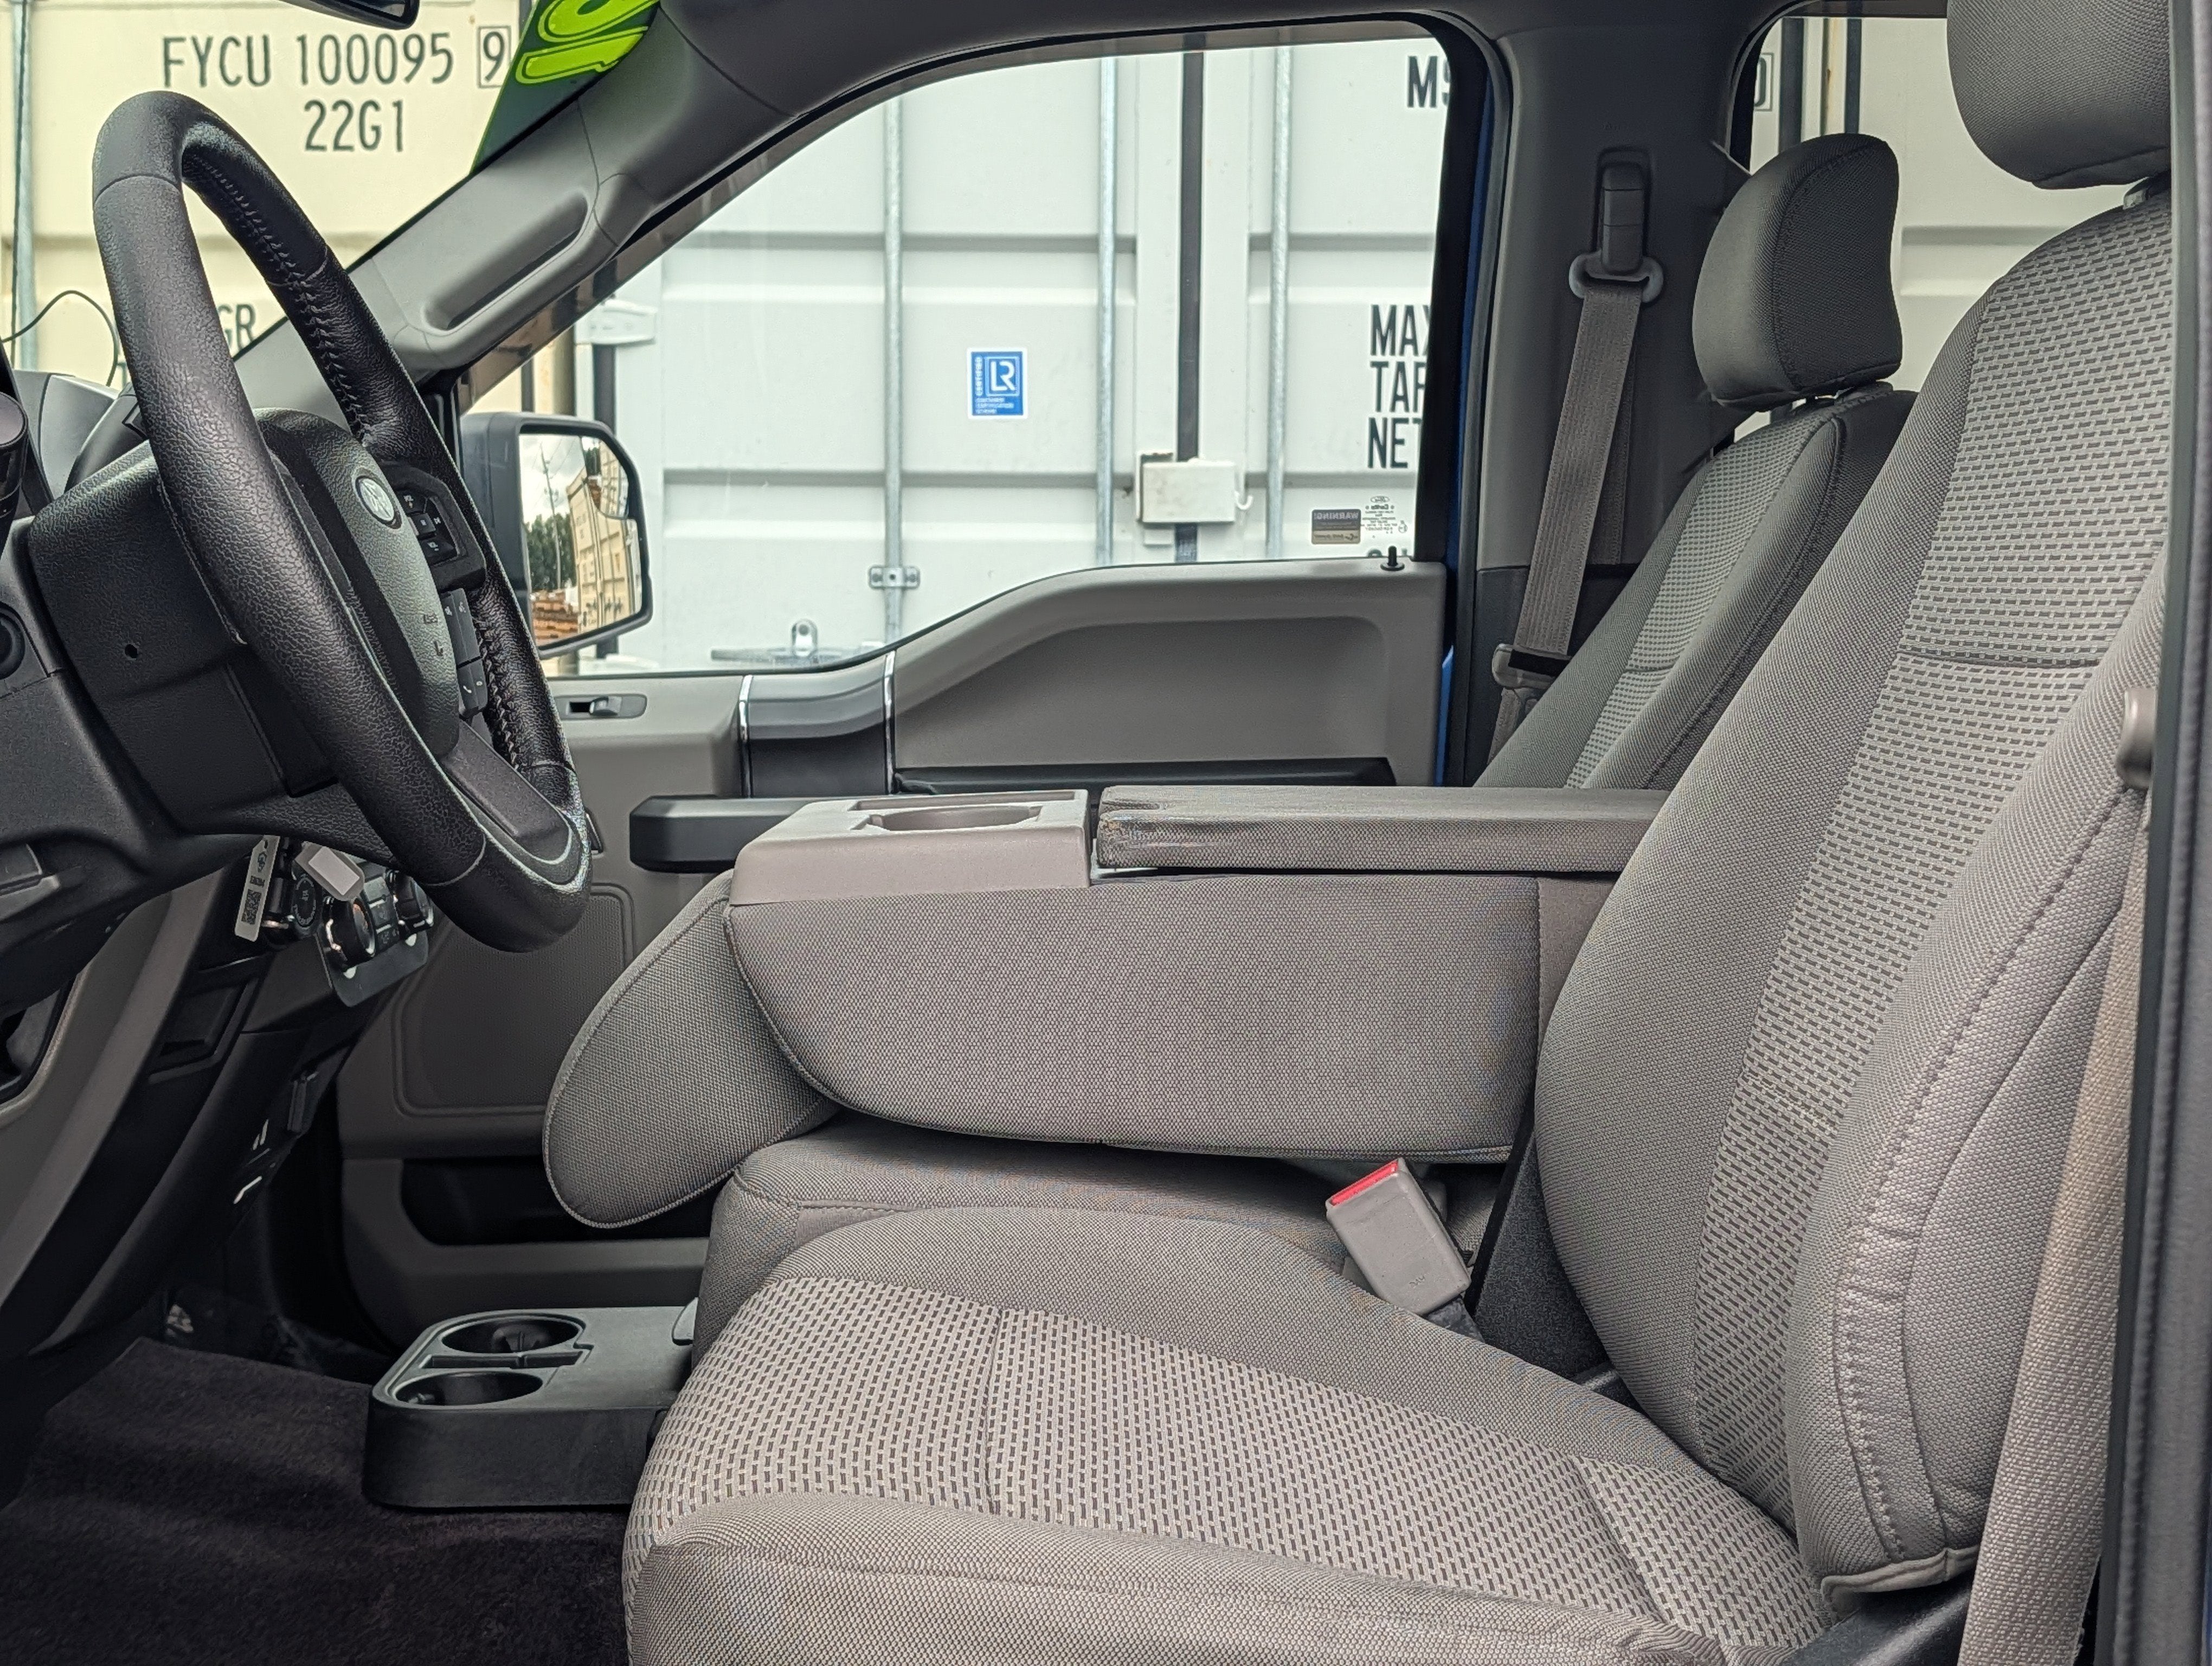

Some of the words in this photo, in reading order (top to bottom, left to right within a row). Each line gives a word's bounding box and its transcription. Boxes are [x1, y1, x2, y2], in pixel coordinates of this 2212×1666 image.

[162, 35, 271, 87] FYCU
[295, 33, 454, 86] 100095
[483, 31, 506, 82] 9
[1407, 55, 1451, 108] M
[304, 99, 404, 152] 22G1
[989, 360, 1016, 392] LR
